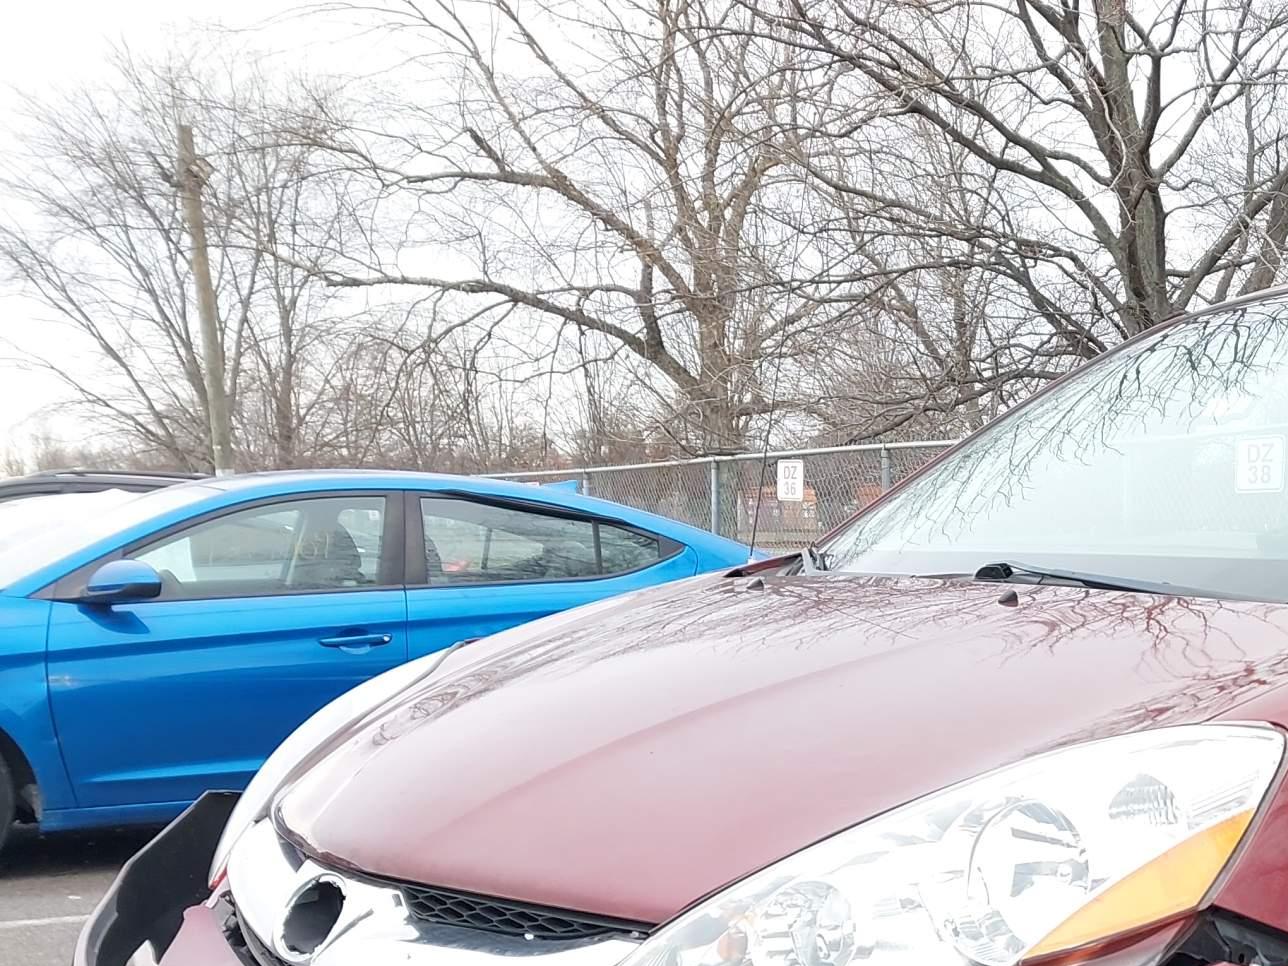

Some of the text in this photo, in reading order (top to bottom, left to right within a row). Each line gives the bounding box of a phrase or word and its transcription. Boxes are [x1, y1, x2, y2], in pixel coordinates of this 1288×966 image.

[1247, 443, 1274, 463] DZ
[783, 465, 798, 480] DZ
[1247, 465, 1271, 484] 38
[783, 481, 797, 496] 36
